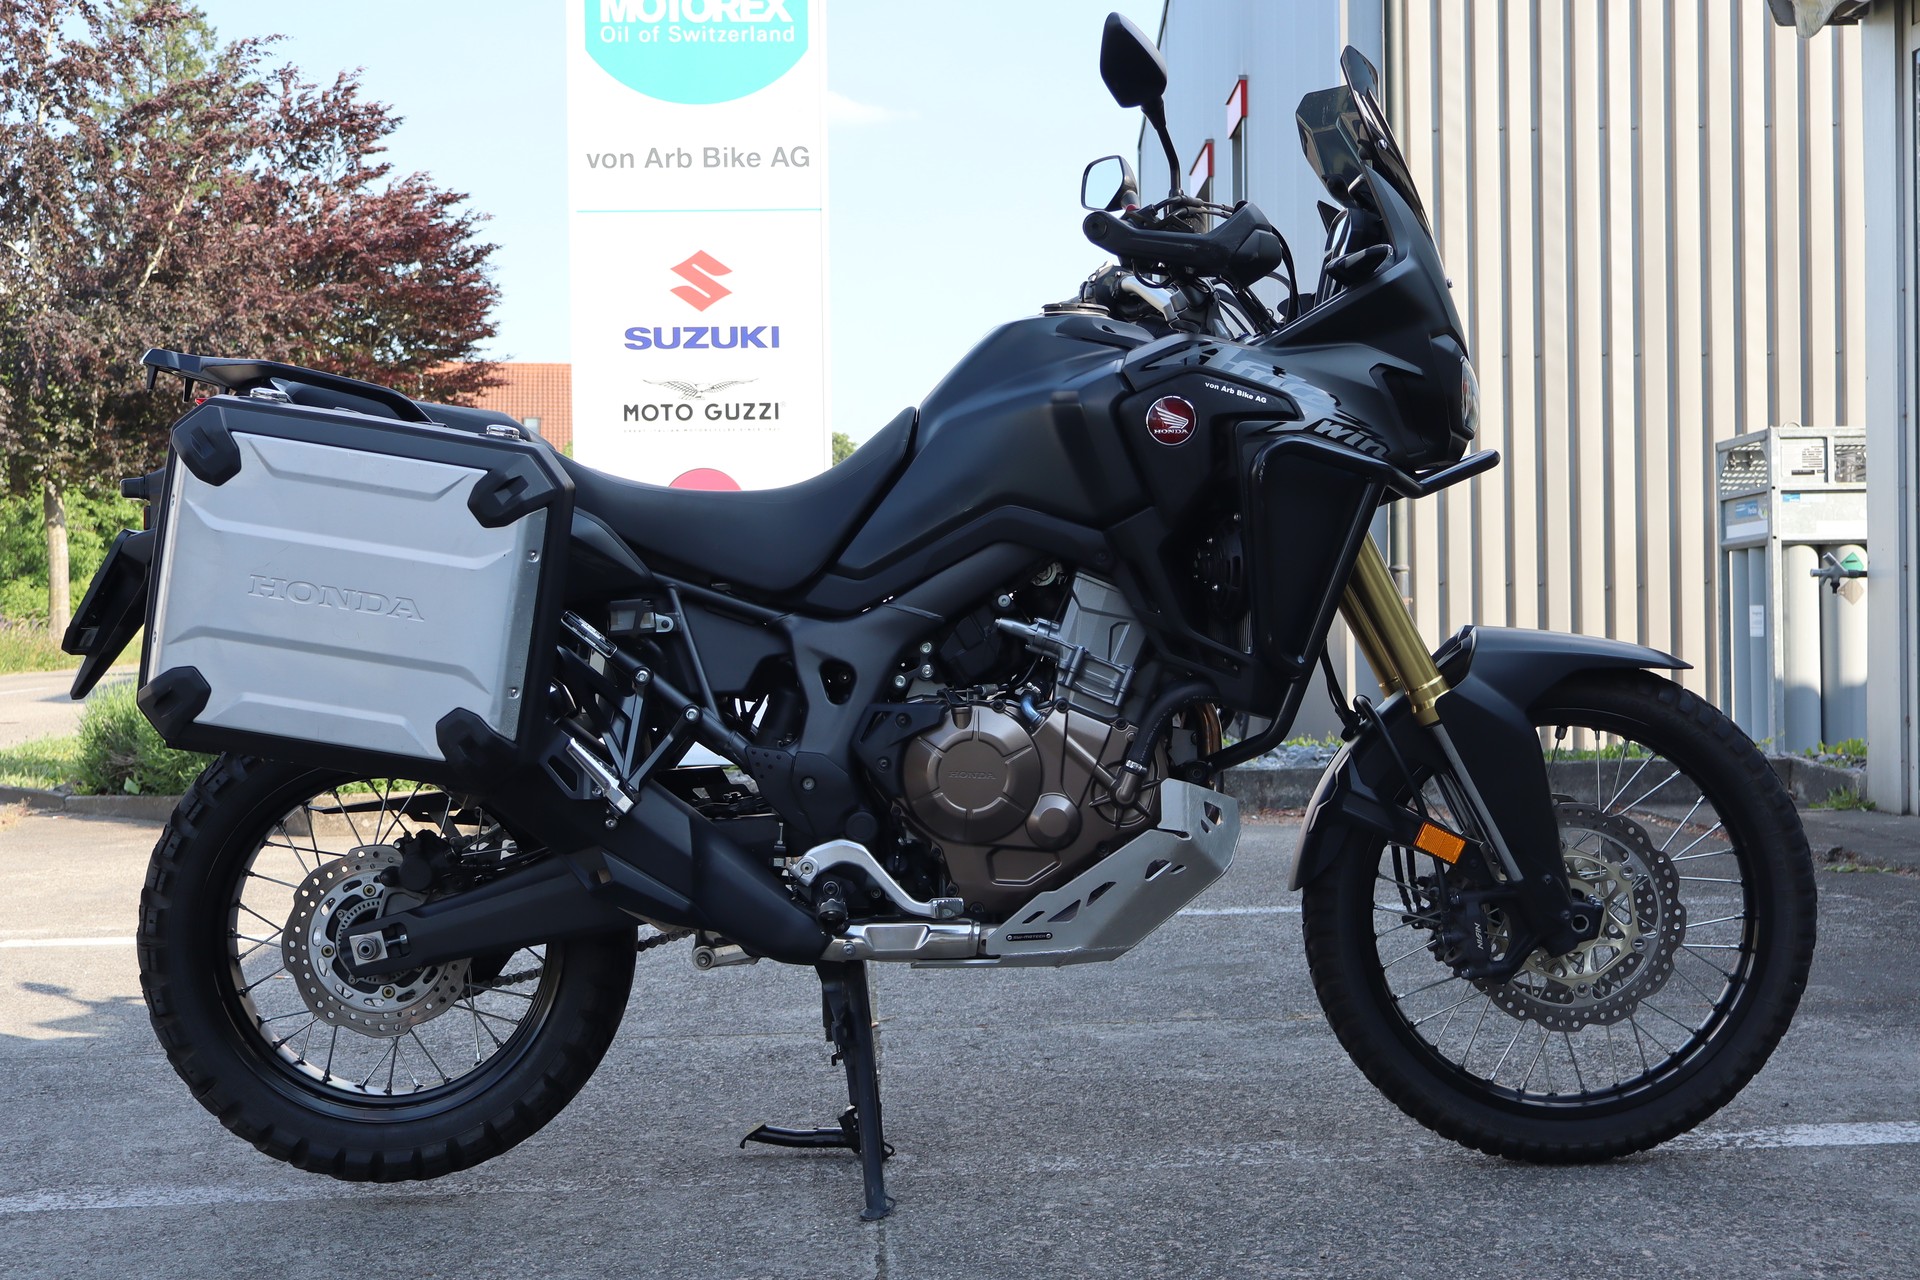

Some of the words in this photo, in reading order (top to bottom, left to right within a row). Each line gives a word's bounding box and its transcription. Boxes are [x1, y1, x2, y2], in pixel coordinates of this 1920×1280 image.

[600, 26, 629, 43] Oil
[638, 25, 660, 43] of
[668, 25, 795, 42] Switzerland
[586, 153, 635, 169] von
[644, 147, 693, 168] Arb
[703, 147, 761, 168] Bike
[770, 146, 810, 168] AG
[624, 326, 780, 350] SUZUKI
[1204, 381, 1220, 391] von
[1220, 385, 1235, 395] Arb
[1236, 389, 1254, 401] Bike
[1255, 395, 1267, 404] AG
[623, 403, 693, 421] MOTO
[704, 402, 779, 420] GUZZI
[248, 573, 425, 622] HONDA
[948, 769, 996, 780] HONDA
